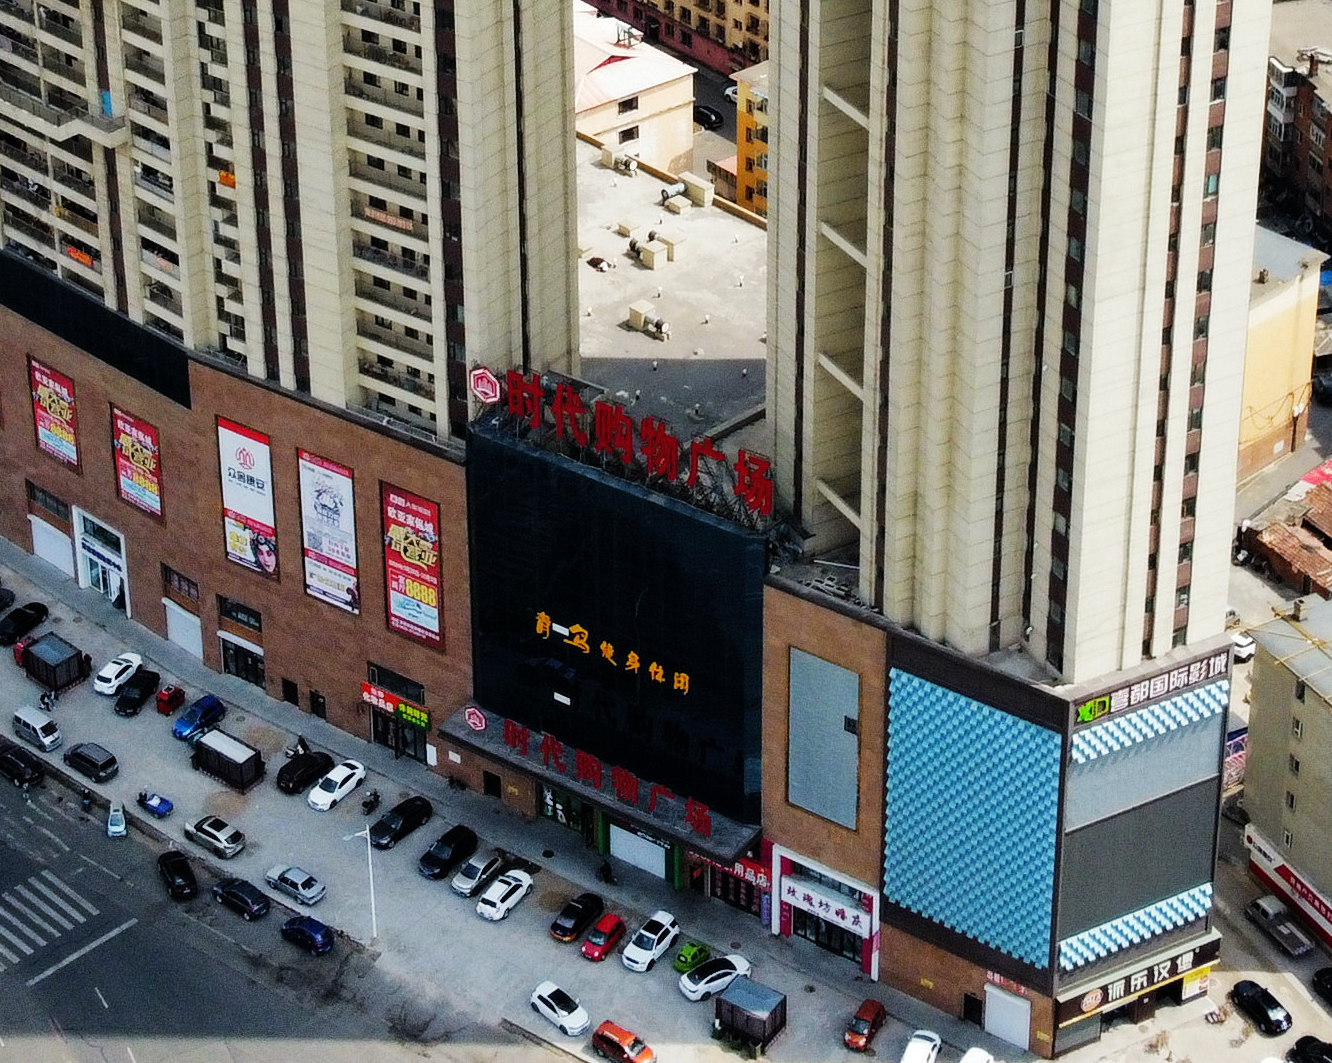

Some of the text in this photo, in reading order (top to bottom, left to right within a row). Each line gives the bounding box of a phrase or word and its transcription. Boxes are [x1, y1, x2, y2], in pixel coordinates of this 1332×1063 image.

[507, 369, 773, 516] 时代购物广场
[406, 578, 437, 607] 8888
[1111, 652, 1228, 713] 喜都国际影城
[504, 718, 712, 837] 时代购物广场
